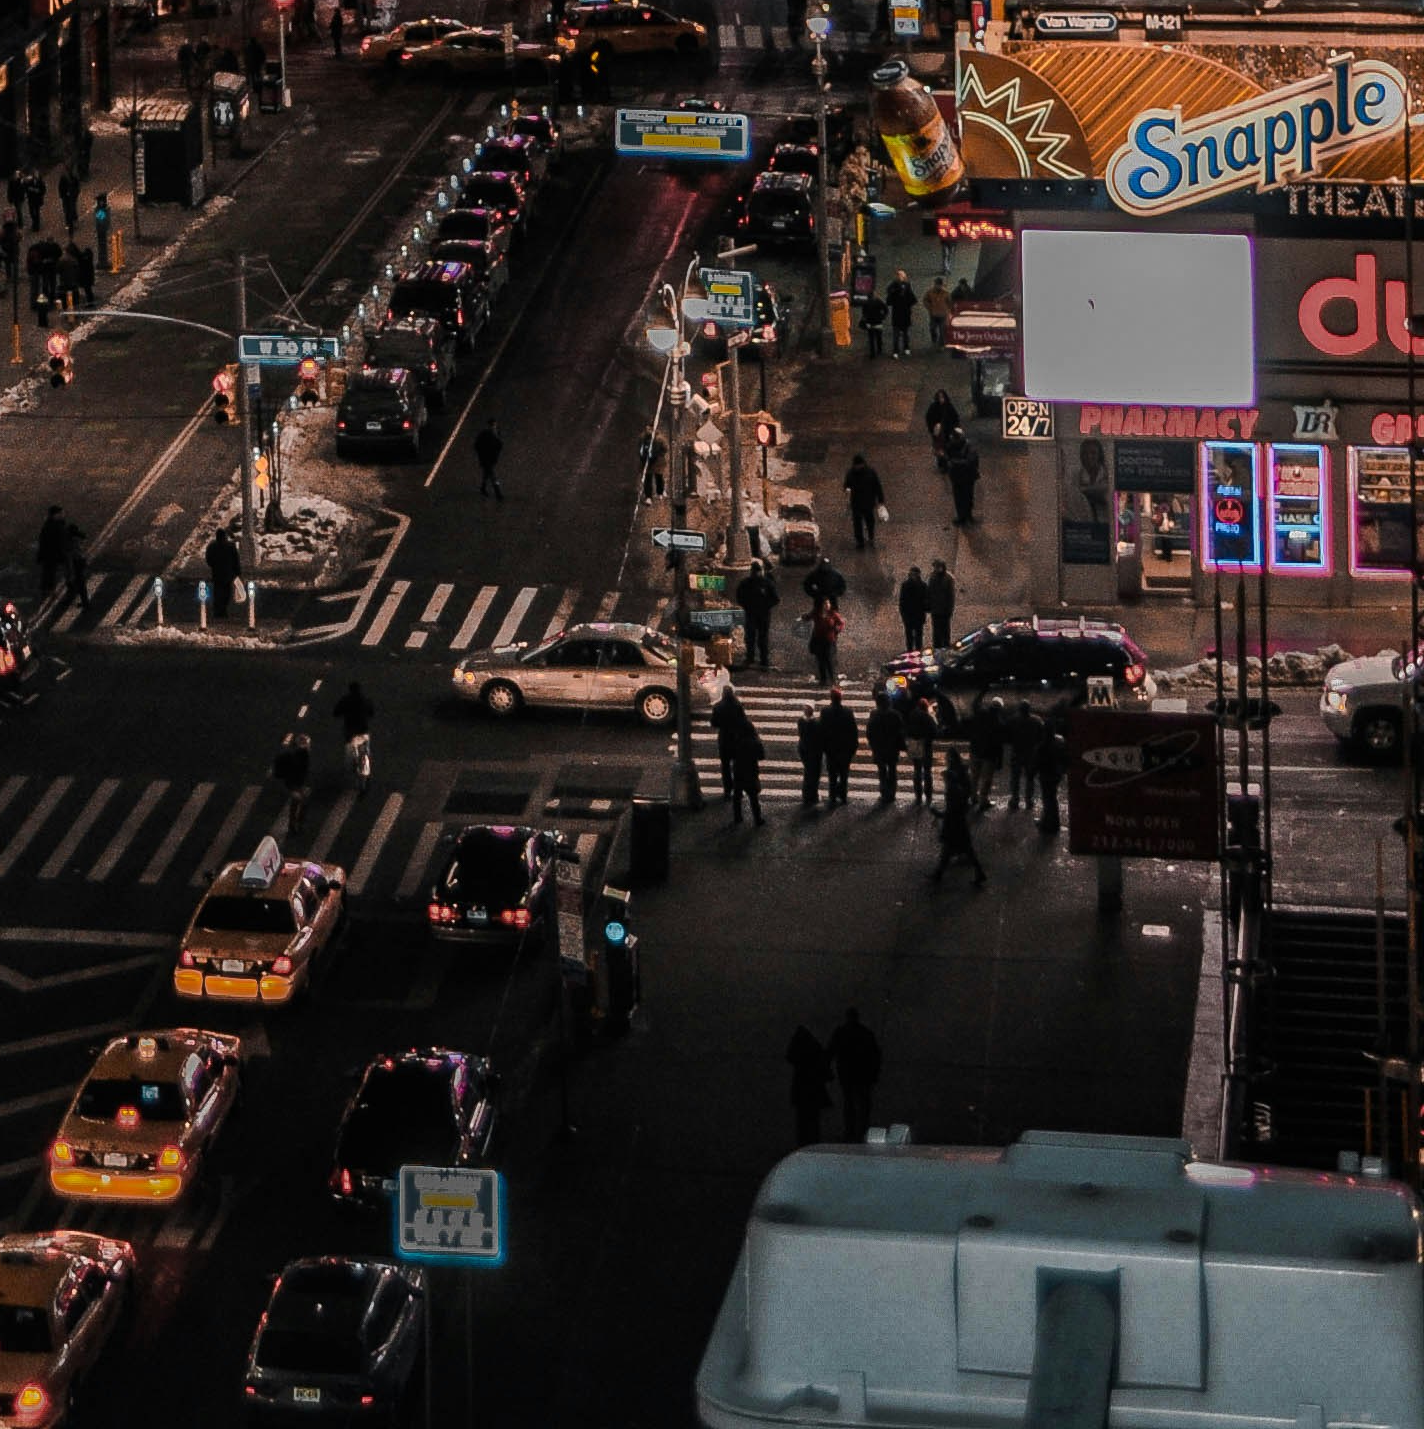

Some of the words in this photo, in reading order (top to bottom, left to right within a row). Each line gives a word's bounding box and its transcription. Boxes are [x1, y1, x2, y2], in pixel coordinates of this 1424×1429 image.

[1044, 15, 1067, 28] Van
[1067, 14, 1111, 31] Wagner
[1127, 61, 1387, 201] Snapple
[258, 340, 273, 355] W
[1006, 400, 1051, 417] OPEN
[1006, 416, 1052, 438] 24/7
[1079, 404, 1260, 440] PHARMACY
[1104, 813, 1138, 830] NOW
